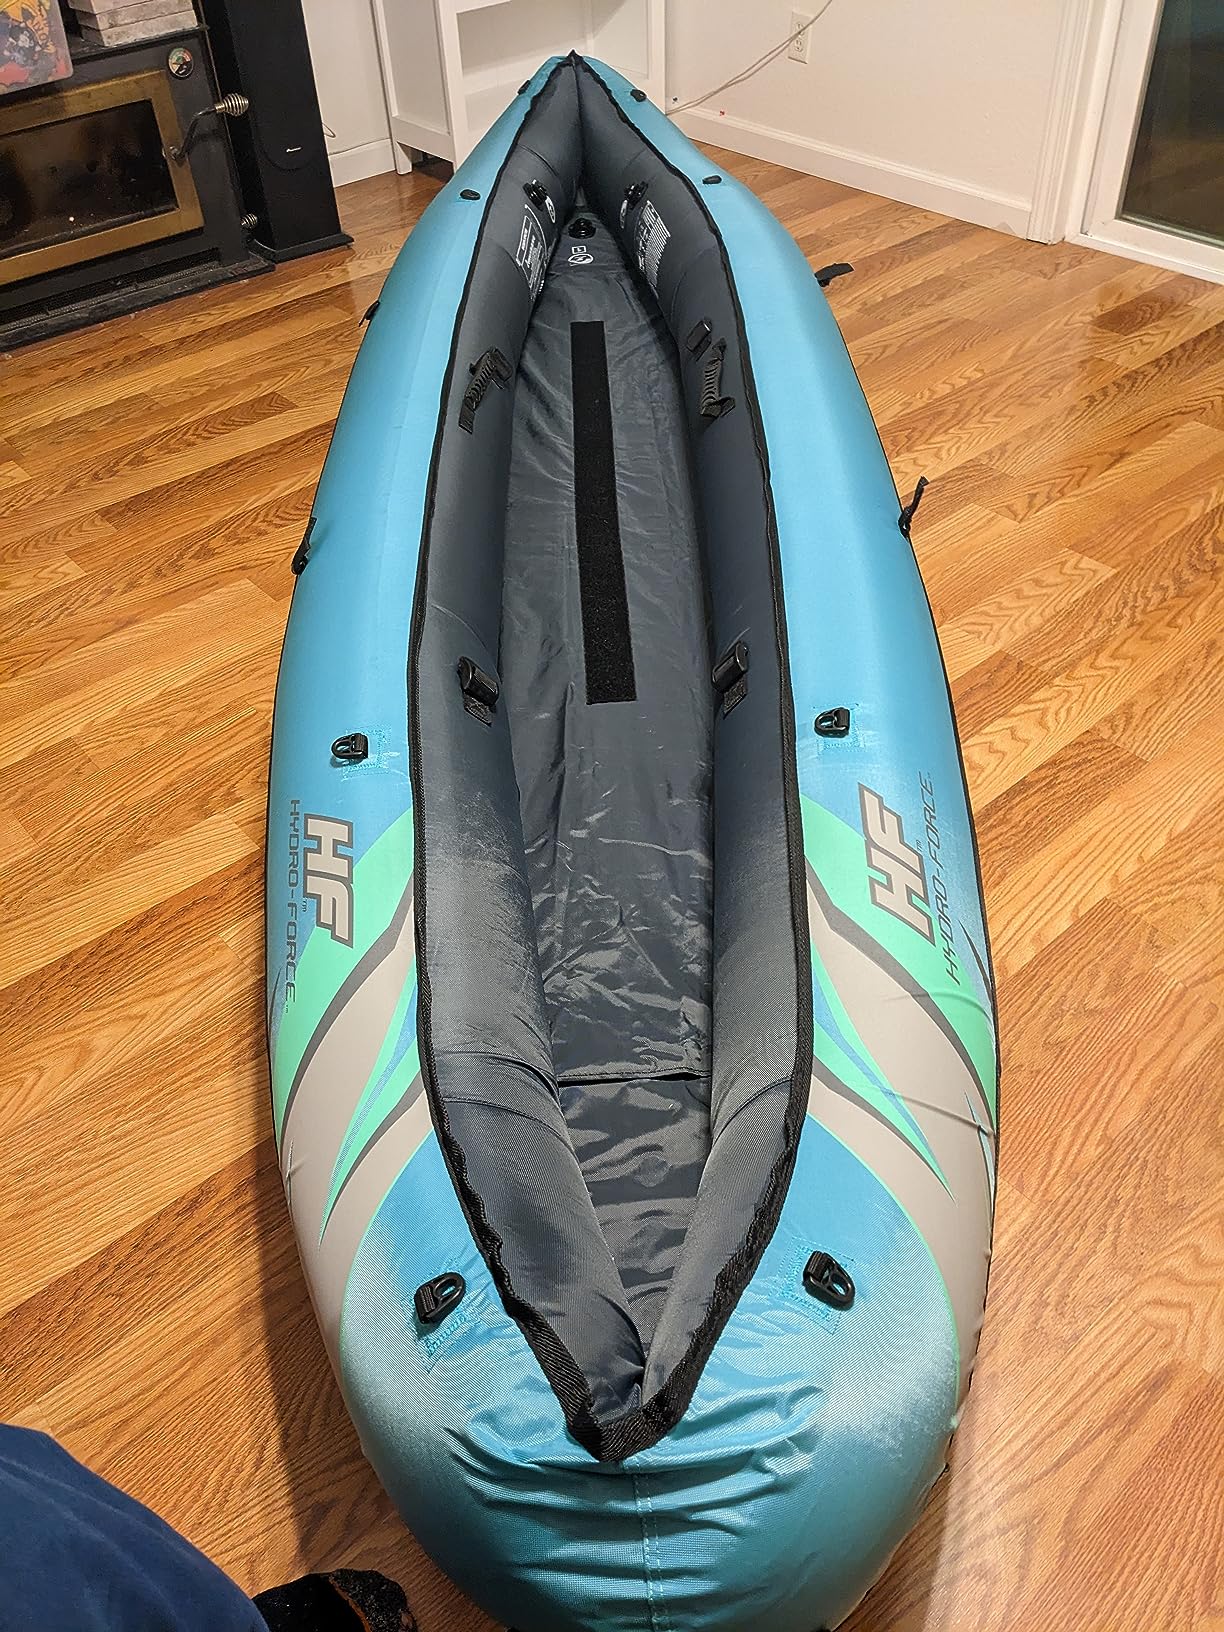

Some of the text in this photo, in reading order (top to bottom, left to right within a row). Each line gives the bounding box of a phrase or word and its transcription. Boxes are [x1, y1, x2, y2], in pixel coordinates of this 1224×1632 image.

[285, 799, 300, 1003] HYDRO-FORCE
[303, 813, 353, 949] HF
[858, 782, 936, 947] HF
[919, 771, 960, 985] HYDRO-FORCE
